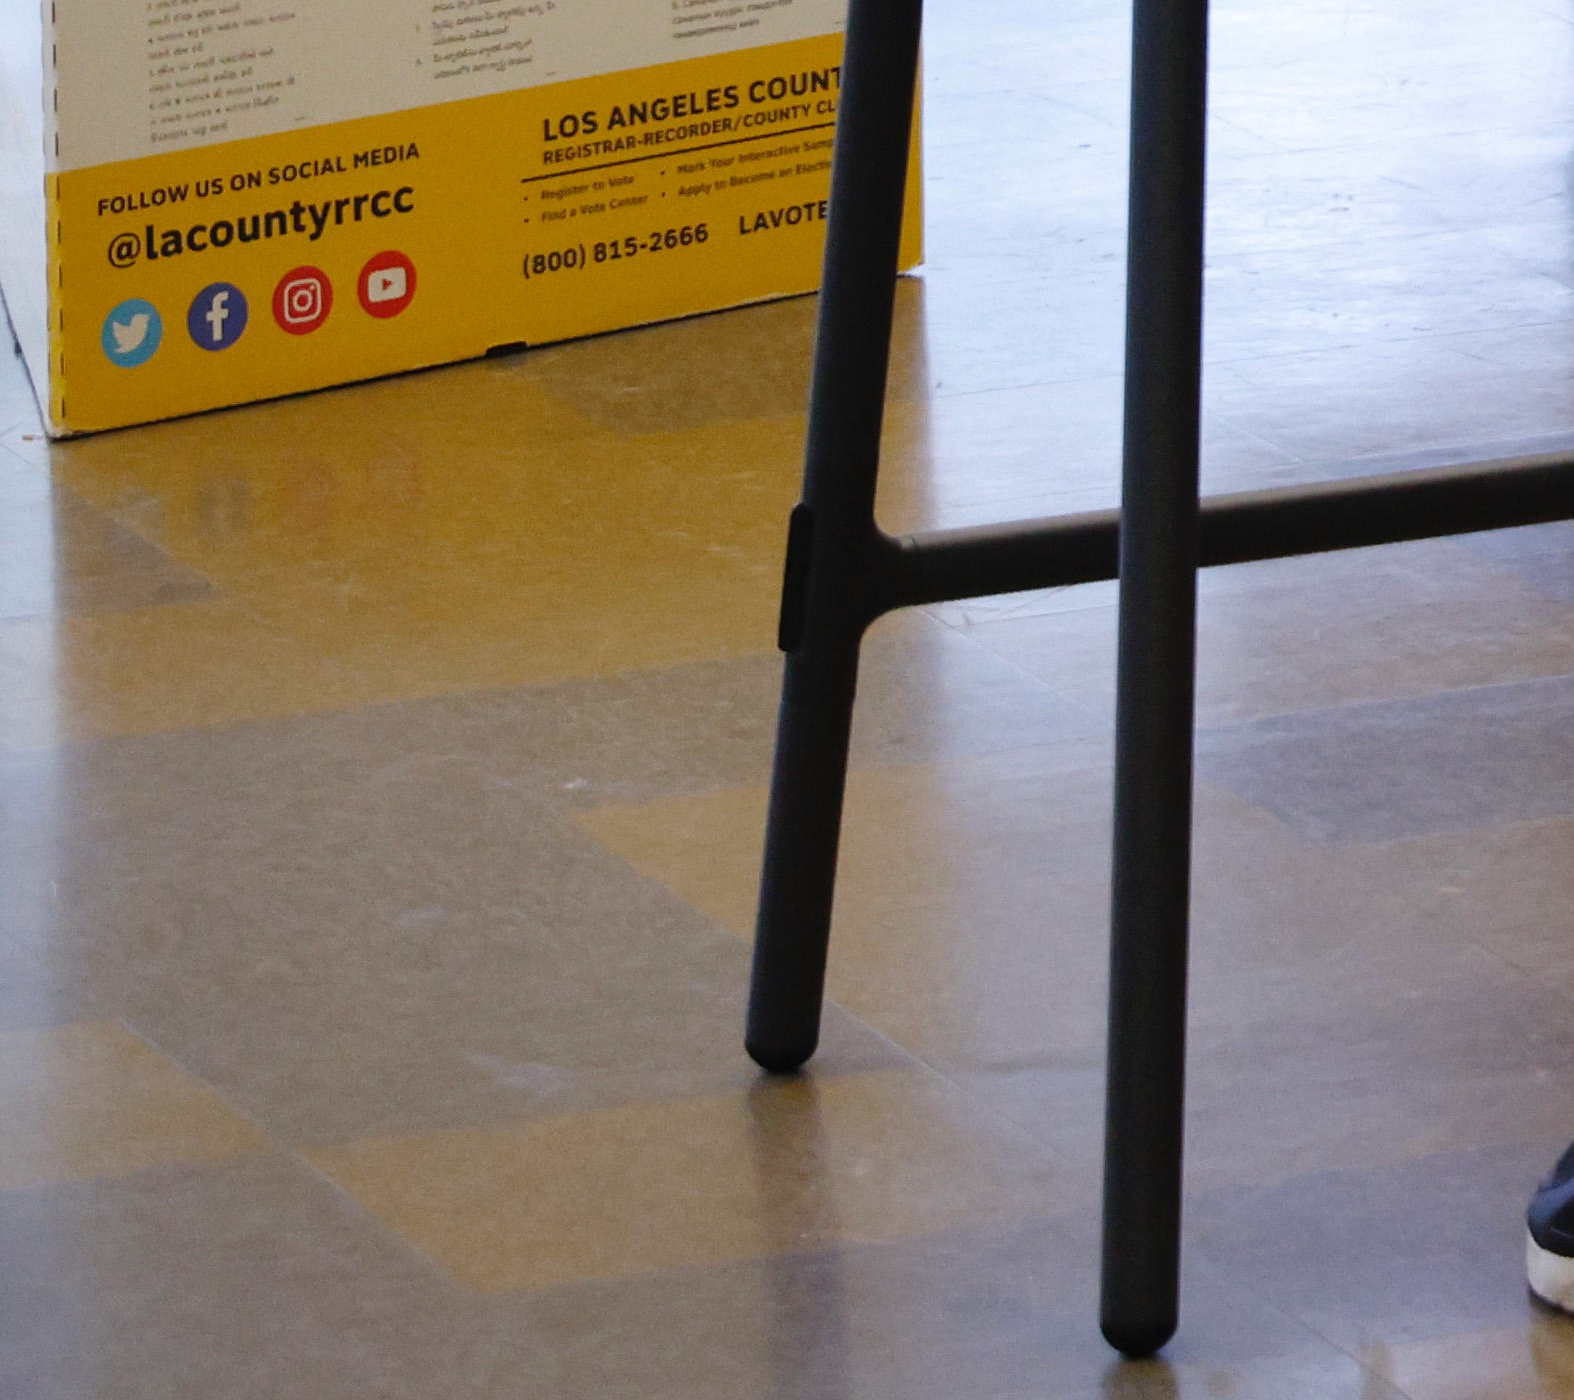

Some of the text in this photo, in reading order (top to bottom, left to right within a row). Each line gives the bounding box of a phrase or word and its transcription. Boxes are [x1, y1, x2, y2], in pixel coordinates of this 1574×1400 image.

[544, 111, 598, 141] LOS
[607, 85, 740, 130] ANGELES
[544, 103, 811, 166] REGISTRAR-RECORDER/COUNTY
[98, 143, 419, 216] FOLLOW US ON SOCIAL MEDIA
[107, 185, 415, 268] @lacountyrrcc
[523, 244, 585, 279] (800)
[594, 223, 708, 263] 815-2666
